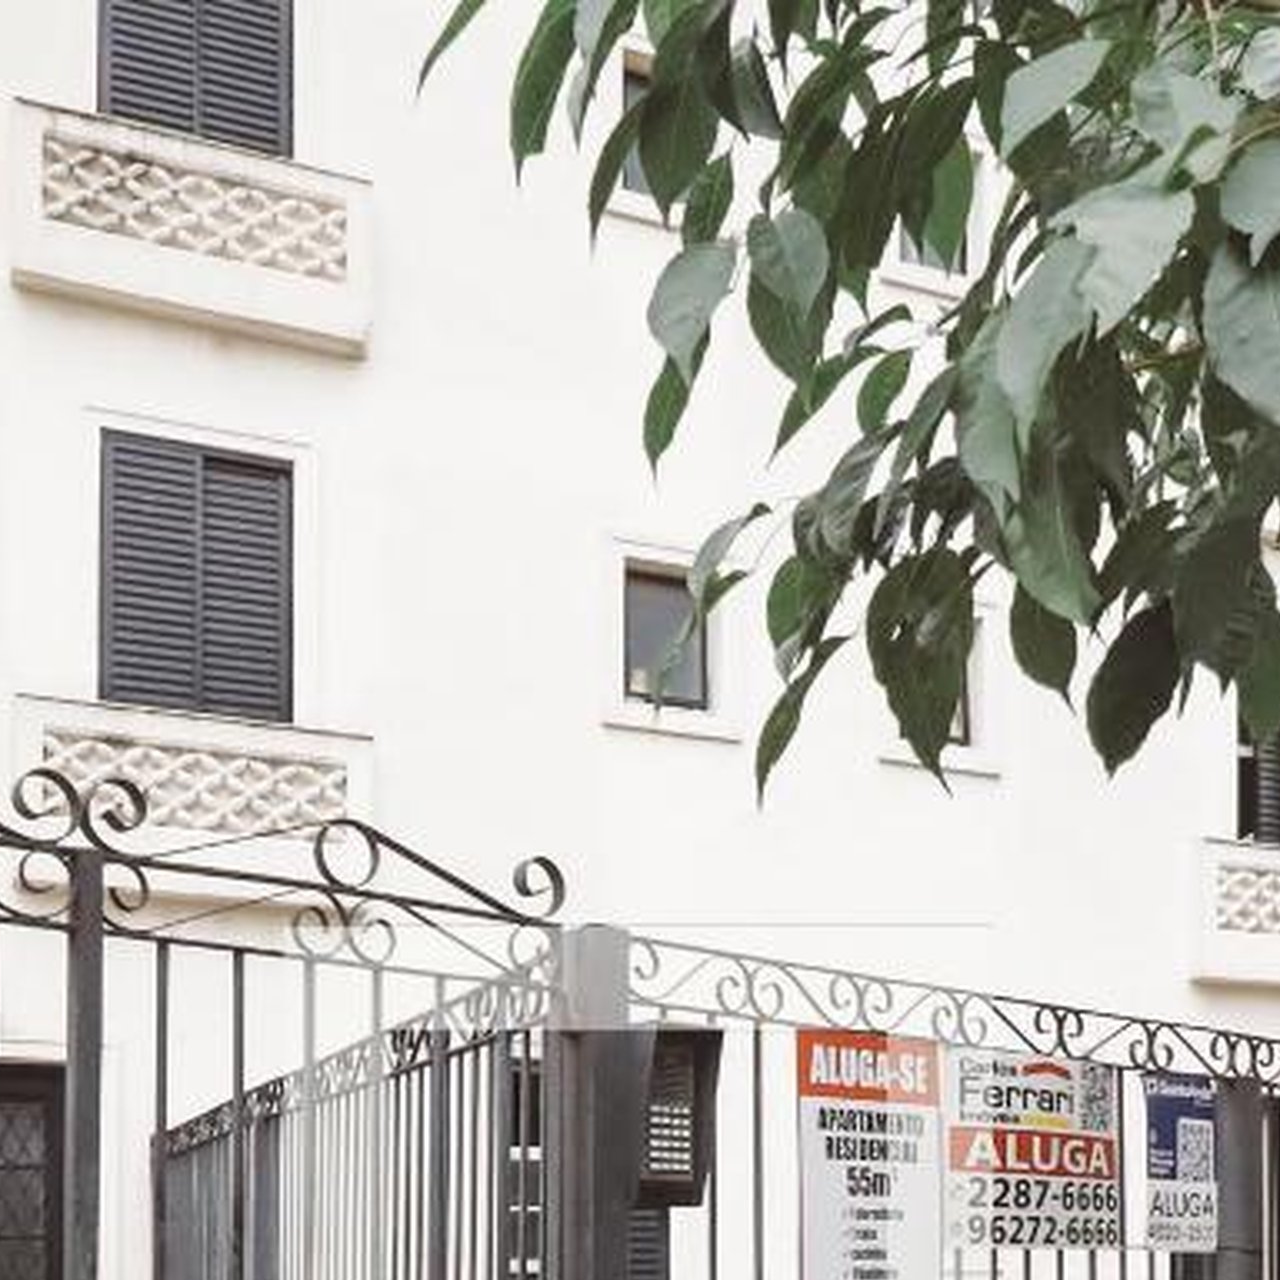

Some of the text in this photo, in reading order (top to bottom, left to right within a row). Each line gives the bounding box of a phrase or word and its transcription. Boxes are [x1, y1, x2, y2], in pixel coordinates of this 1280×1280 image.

[810, 1042, 928, 1095] ALUGA-SE
[959, 1077, 1075, 1115] Ferrari
[818, 1107, 925, 1138] APARTAMENTO
[825, 1135, 919, 1164] RESIDENCIAL
[966, 1131, 1110, 1176] ALUGA
[968, 1177, 1118, 1212] 2287-6666
[1148, 1190, 1215, 1218] ALUGA
[967, 1214, 1118, 1247] 96272-6666
